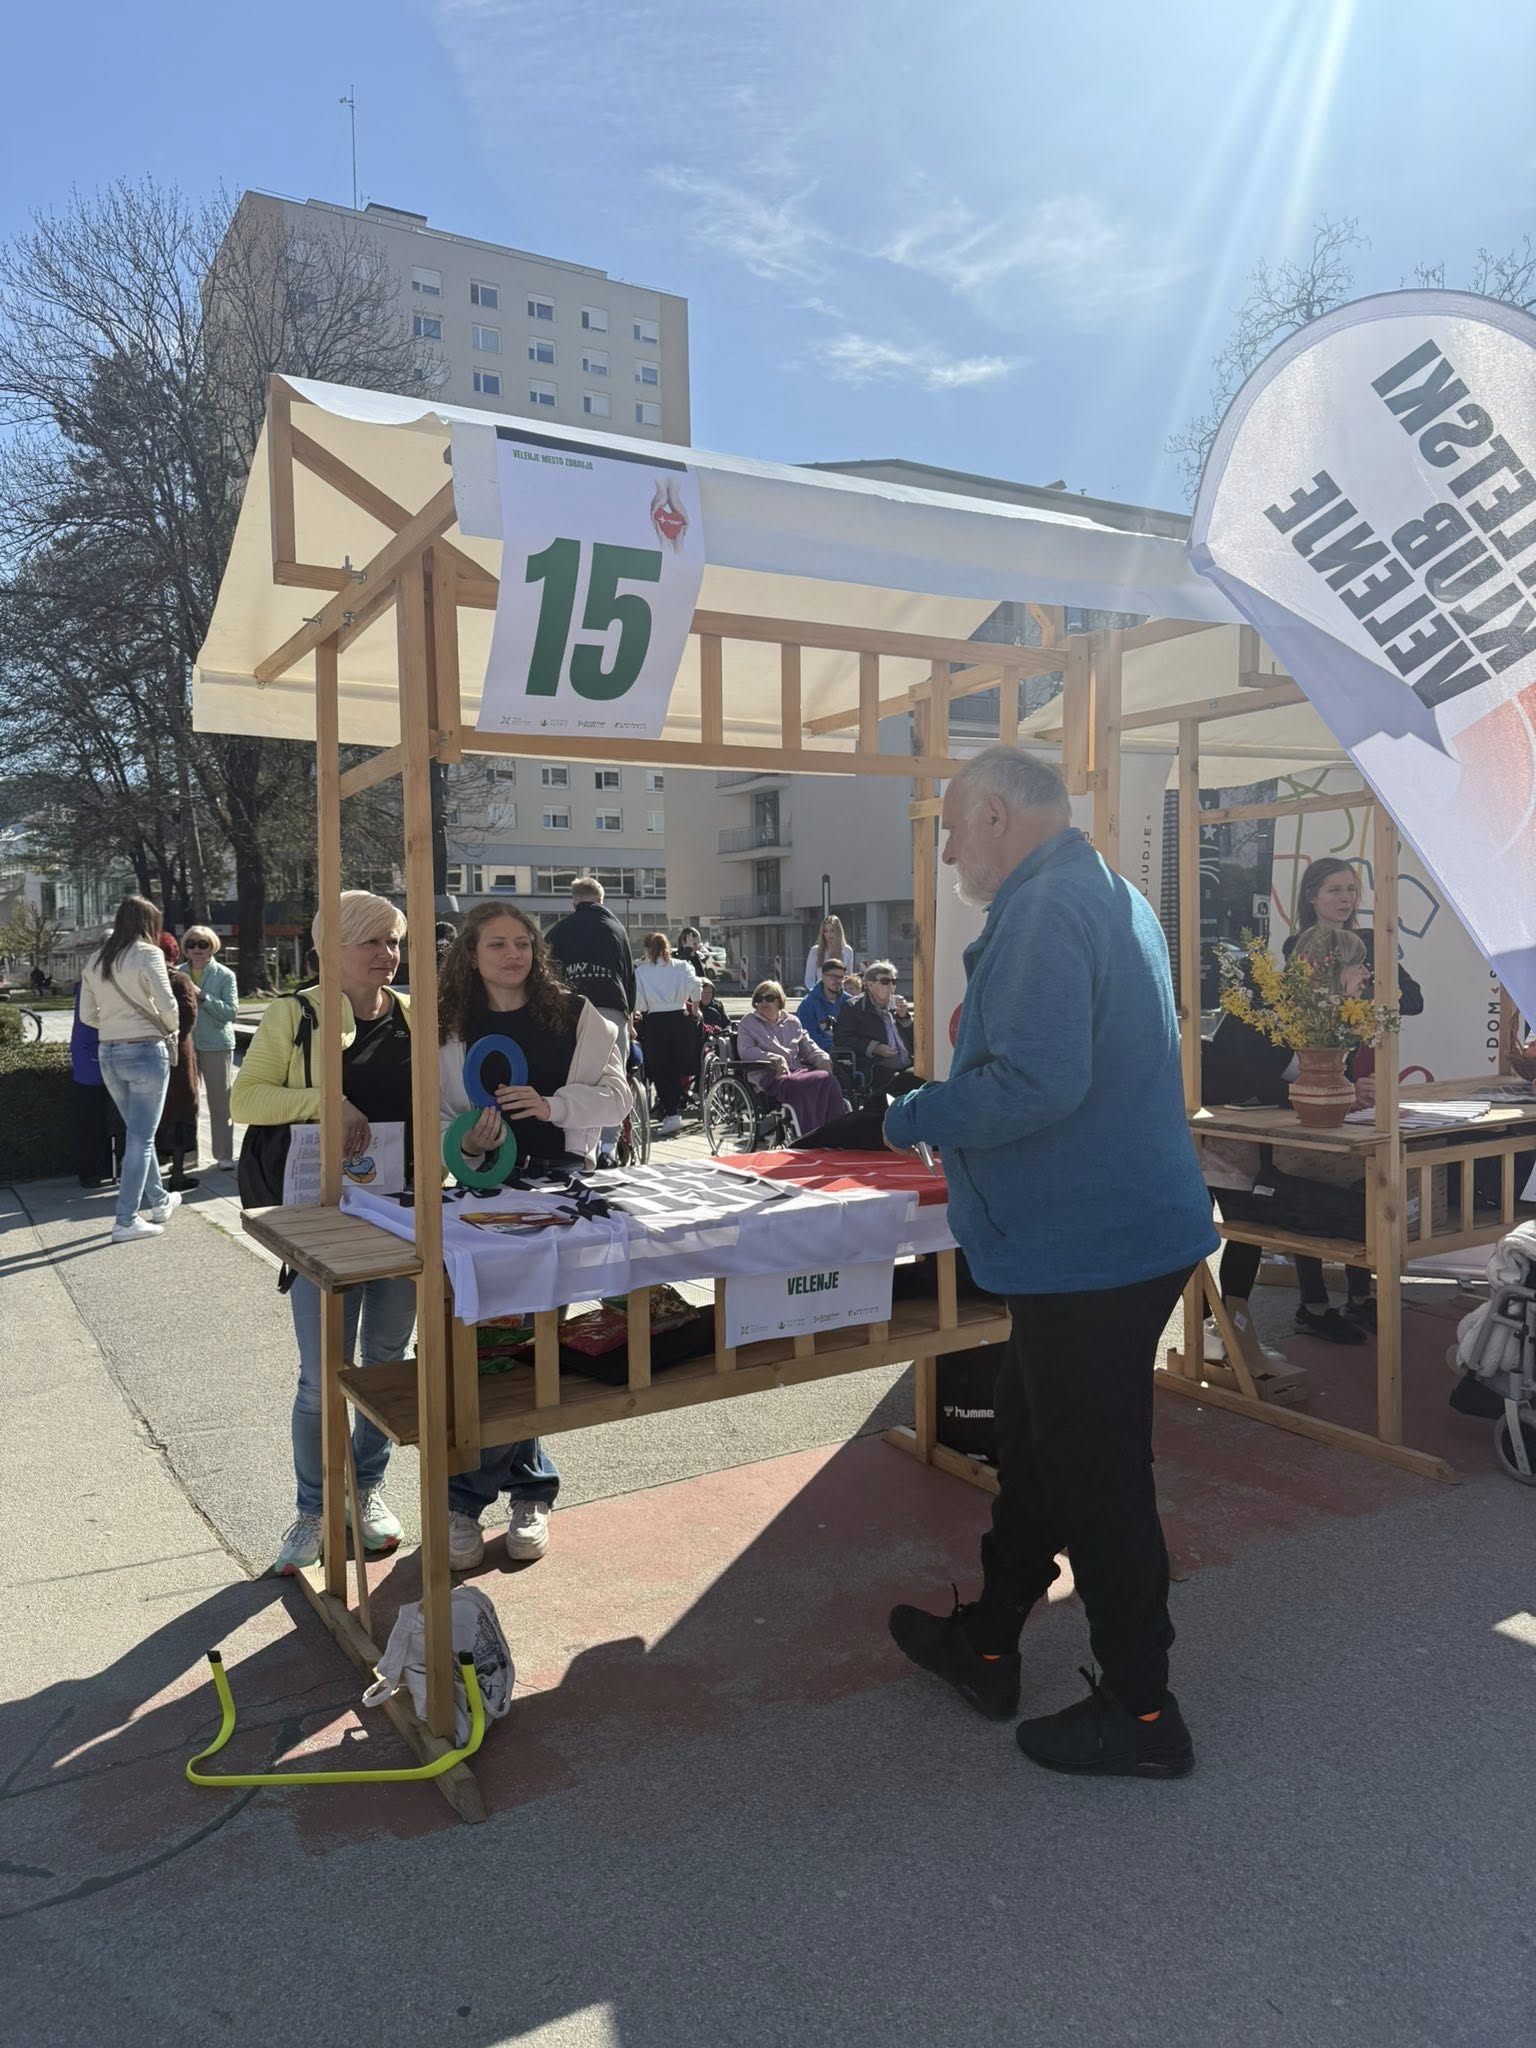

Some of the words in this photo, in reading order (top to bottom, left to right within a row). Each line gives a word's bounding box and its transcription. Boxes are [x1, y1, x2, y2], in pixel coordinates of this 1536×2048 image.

[512, 449, 540, 462] VELENJE
[541, 454, 564, 466] MESTO
[565, 457, 594, 470] ZDRAVJA
[524, 537, 663, 701] 15
[1486, 1002, 1501, 1049] DOM
[787, 1271, 840, 1296] VELENJE
[954, 1405, 995, 1418] humme
